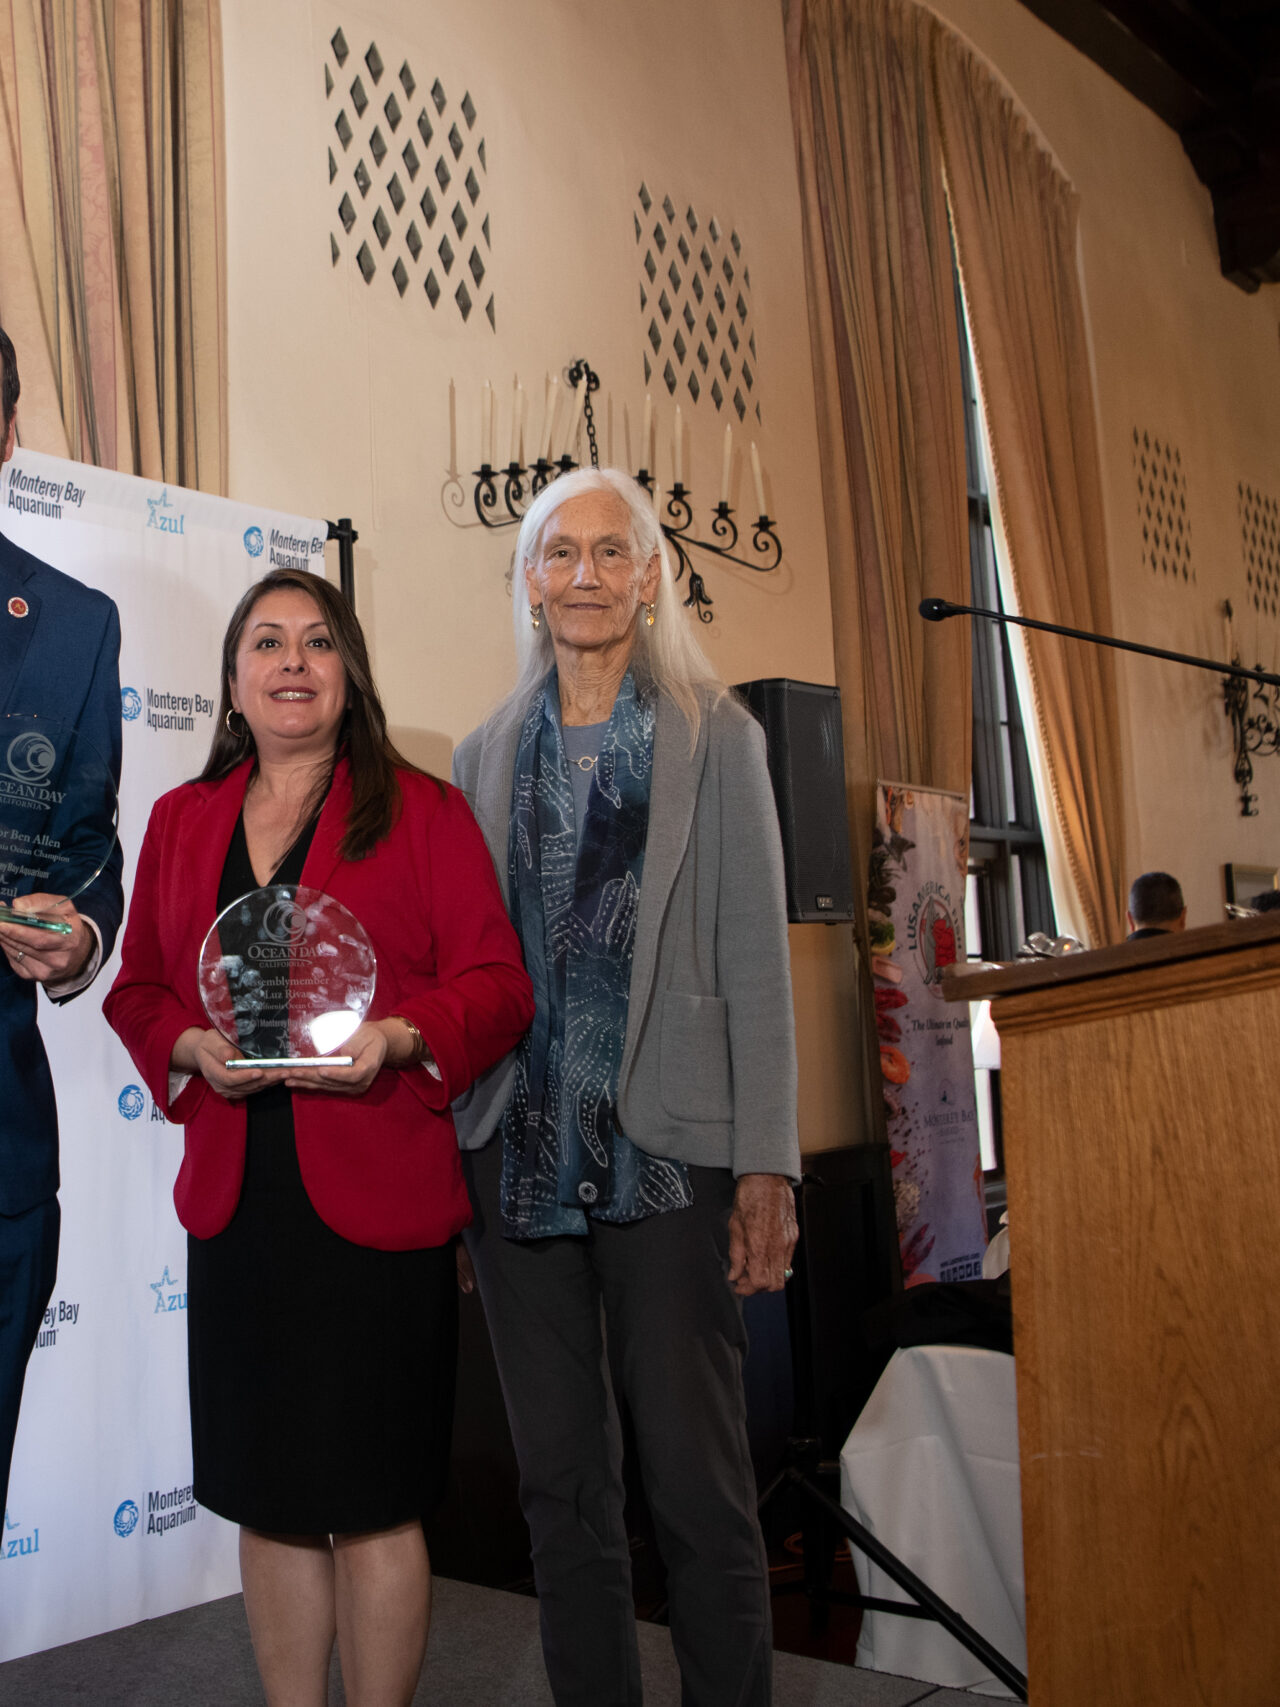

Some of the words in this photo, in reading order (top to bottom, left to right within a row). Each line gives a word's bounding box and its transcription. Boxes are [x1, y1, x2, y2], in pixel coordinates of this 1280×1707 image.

[8, 468, 64, 503] Monterey
[64, 481, 86, 508] Bay
[8, 489, 62, 520] Aquarium
[146, 506, 184, 535] Azul
[269, 528, 310, 558] Monterey
[146, 688, 194, 716] Monterey
[195, 694, 214, 717] Bay
[146, 708, 194, 732] Aquarium
[39, 788, 67, 804] DAY
[10, 829, 31, 843] Ben
[32, 834, 61, 848] Allen
[9, 845, 32, 856] Ocean
[33, 849, 70, 863] Champion
[8, 862, 20, 875] Bay
[247, 945, 297, 959] OCEAN
[300, 947, 318, 957] DA
[59, 1300, 80, 1325] Bay
[153, 1287, 188, 1314] Azu
[148, 1485, 195, 1512] Monterey
[147, 1505, 196, 1536] Aquarium
